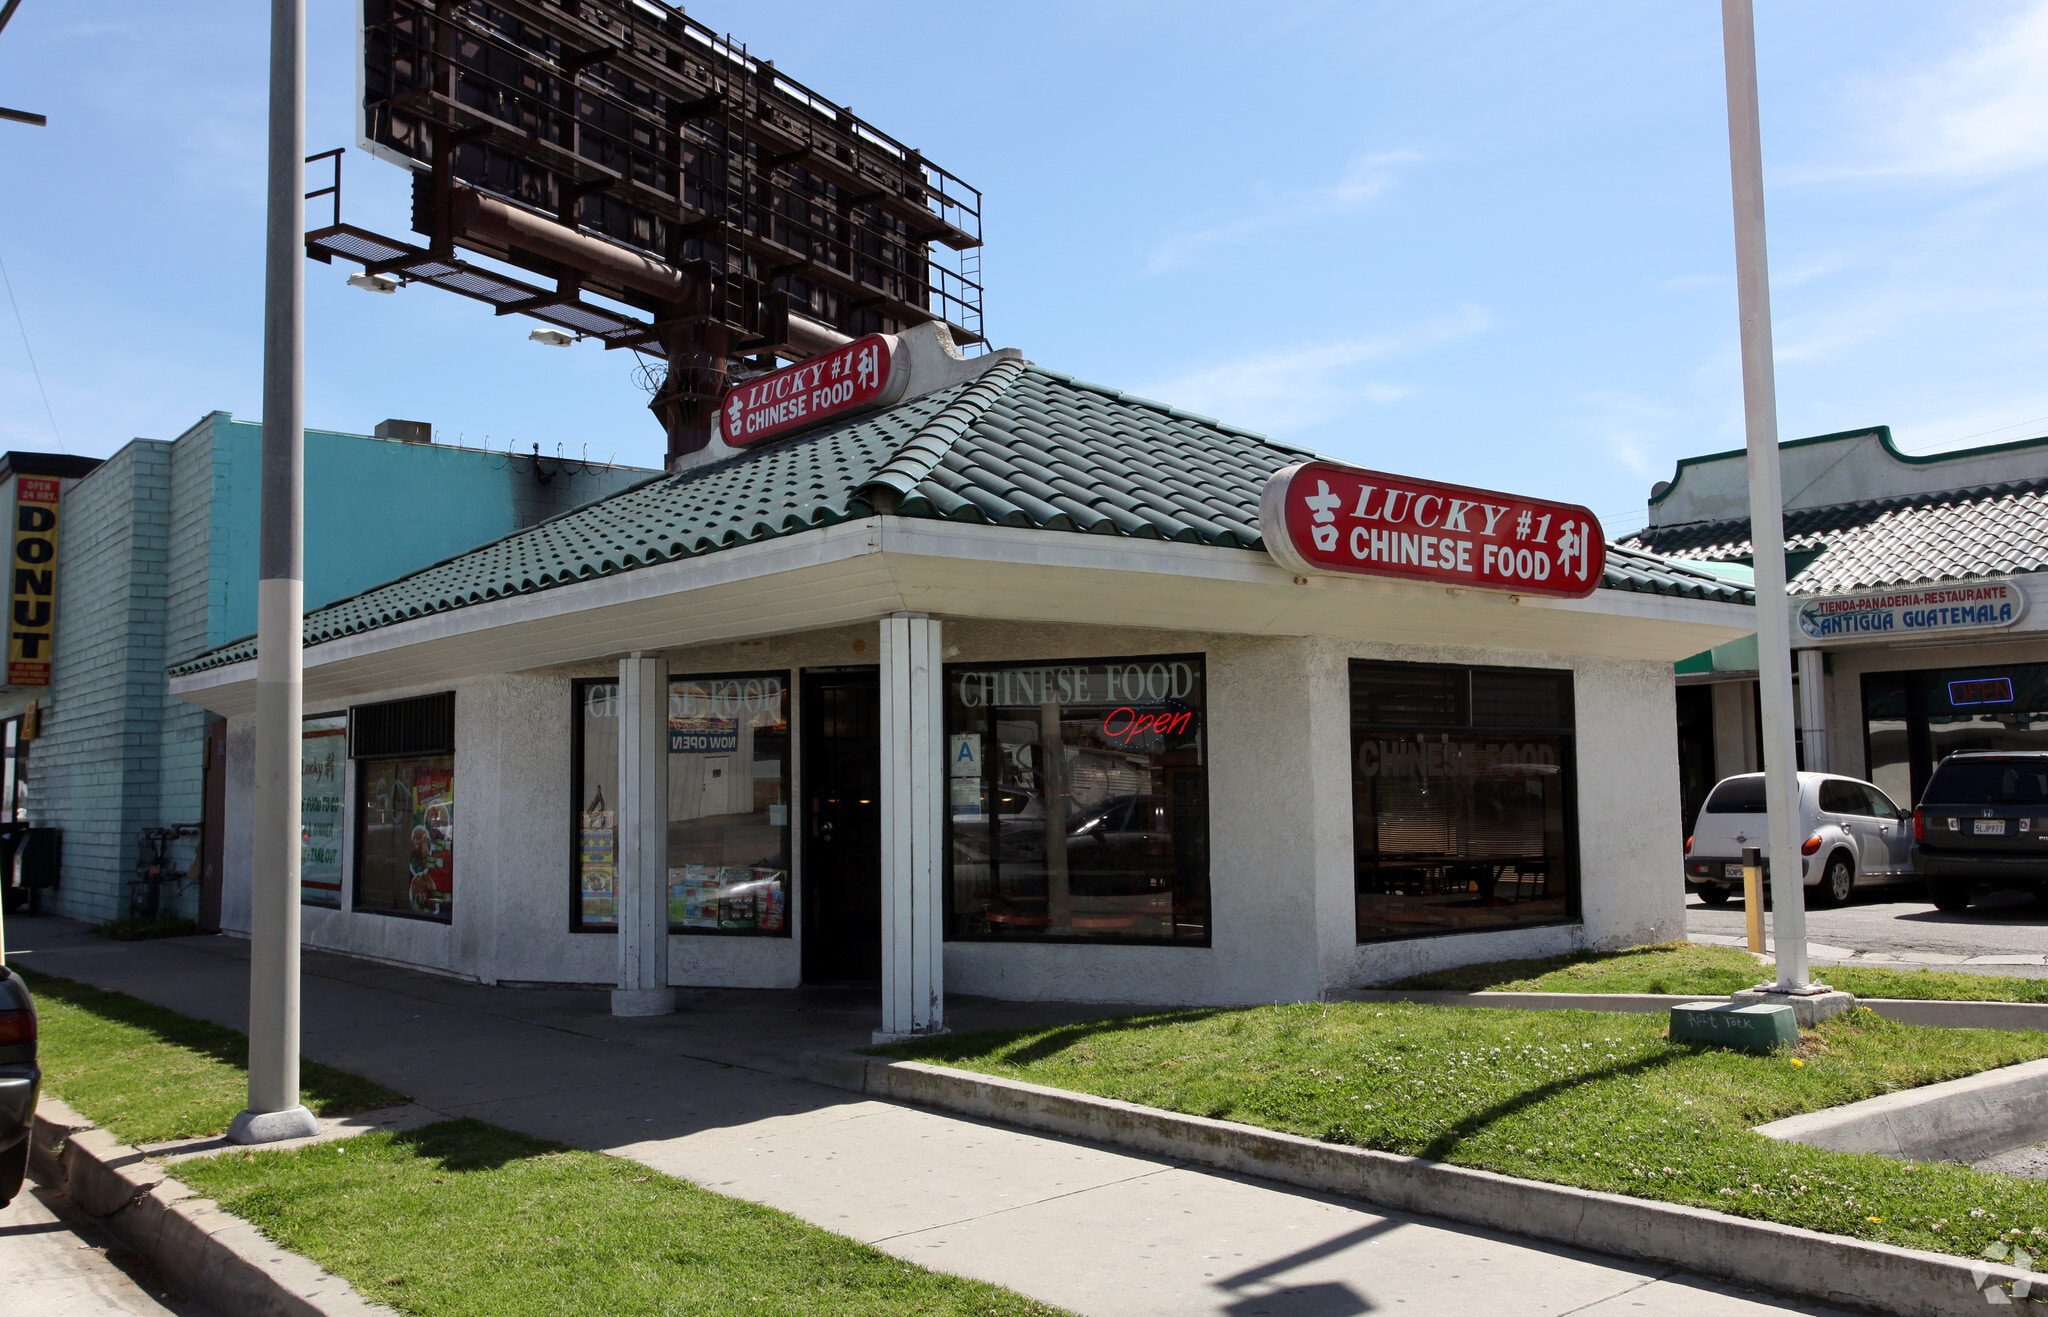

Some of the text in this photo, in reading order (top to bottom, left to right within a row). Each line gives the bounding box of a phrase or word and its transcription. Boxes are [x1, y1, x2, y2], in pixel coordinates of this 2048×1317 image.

[746, 351, 854, 411] LUCKY #1
[857, 344, 879, 390] 利
[728, 396, 743, 437] 吉
[746, 379, 854, 434] CHINESE FOOD
[27, 481, 51, 491] OPEN
[1305, 479, 1342, 552] 吉
[1350, 484, 1552, 544] LUCKY #1
[1350, 526, 1551, 581] CHINESE FOOD
[1557, 519, 1589, 582] 利
[12, 504, 56, 659] DONUT
[1820, 603, 2012, 636] ANTIGUA GUATEMALA
[710, 678, 781, 718] FOOD
[960, 662, 1193, 708] CHINESE FOOD
[1951, 681, 2010, 703] OPEN
[1103, 707, 1192, 745] Open
[957, 741, 974, 762] A
[1359, 740, 1554, 777] CHINESE FOOD
